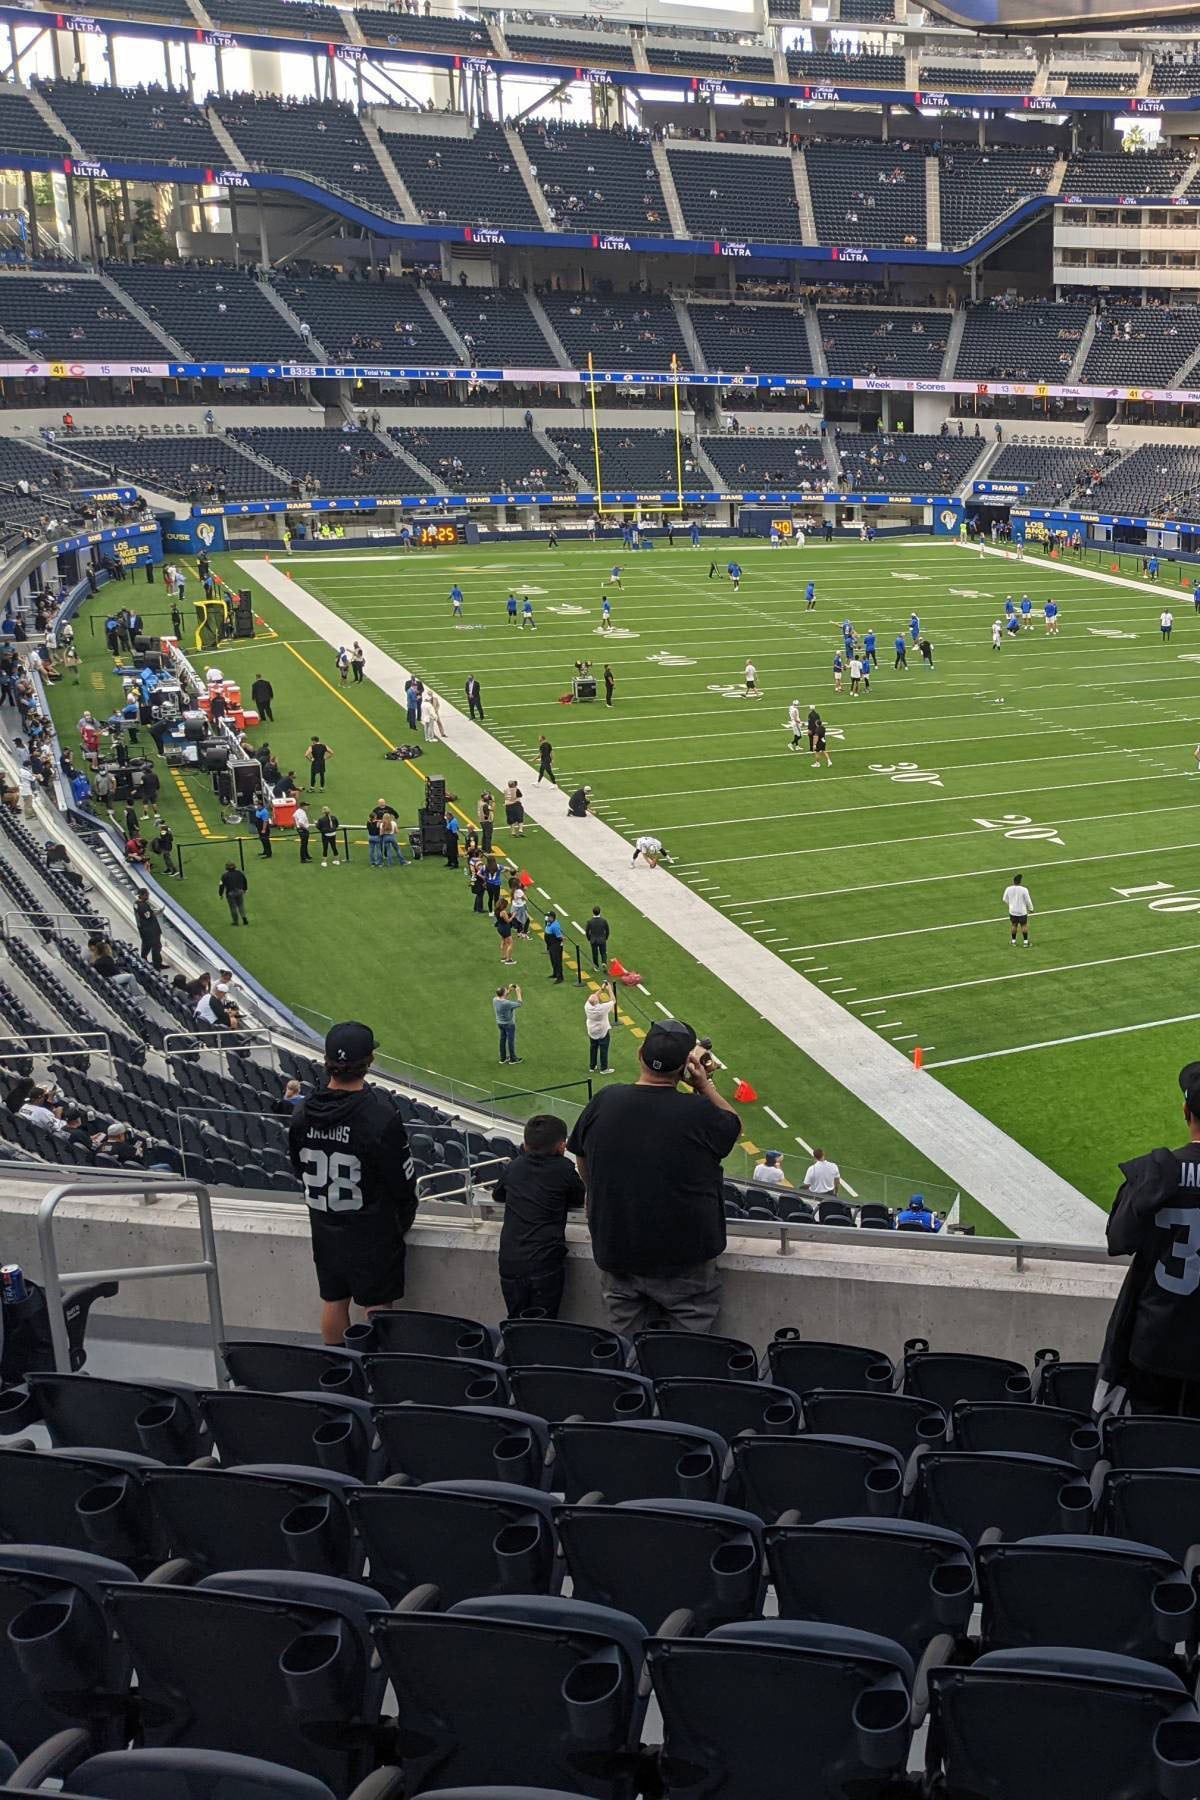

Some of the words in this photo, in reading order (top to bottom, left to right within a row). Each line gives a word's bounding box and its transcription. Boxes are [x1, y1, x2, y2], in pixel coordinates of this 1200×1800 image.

[66, 22, 101, 33] ULTRA
[205, 37, 238, 48] ULTRA
[337, 50, 368, 61] ULTRA
[462, 63, 493, 73] ULTRA
[583, 74, 612, 84] ULTRA
[699, 83, 727, 93] ULTRA
[811, 91, 839, 100] ULTRA
[922, 97, 949, 106] ULTRA
[1030, 101, 1057, 109] ULTRA
[1137, 102, 1165, 111] ULTRA
[73, 167, 108, 178] ULTRA
[215, 176, 250, 187] ULTRA
[473, 233, 505, 244] ULTRA
[600, 241, 631, 251] ULTRA
[721, 246, 751, 256] ULTRA
[839, 252, 868, 262] ULTRA
[53, 366, 64, 374] 41
[100, 366, 110, 374] 15
[130, 366, 152, 374] FINAL
[290, 368, 316, 376] 83:25
[335, 368, 345, 376] Q1
[866, 380, 890, 389] Week
[916, 382, 946, 391] Scores
[1001, 385, 1009, 393] 13
[1130, 390, 1138, 398] 41
[992, 484, 1018, 492] RAMS
[1080, 514, 1100, 522] RAMS
[114, 541, 129, 551] LOS
[868, 762, 940, 783] 30
[972, 814, 1058, 841] 20
[306, 1126, 351, 1144] JACOBS
[299, 1147, 364, 1213] 28
